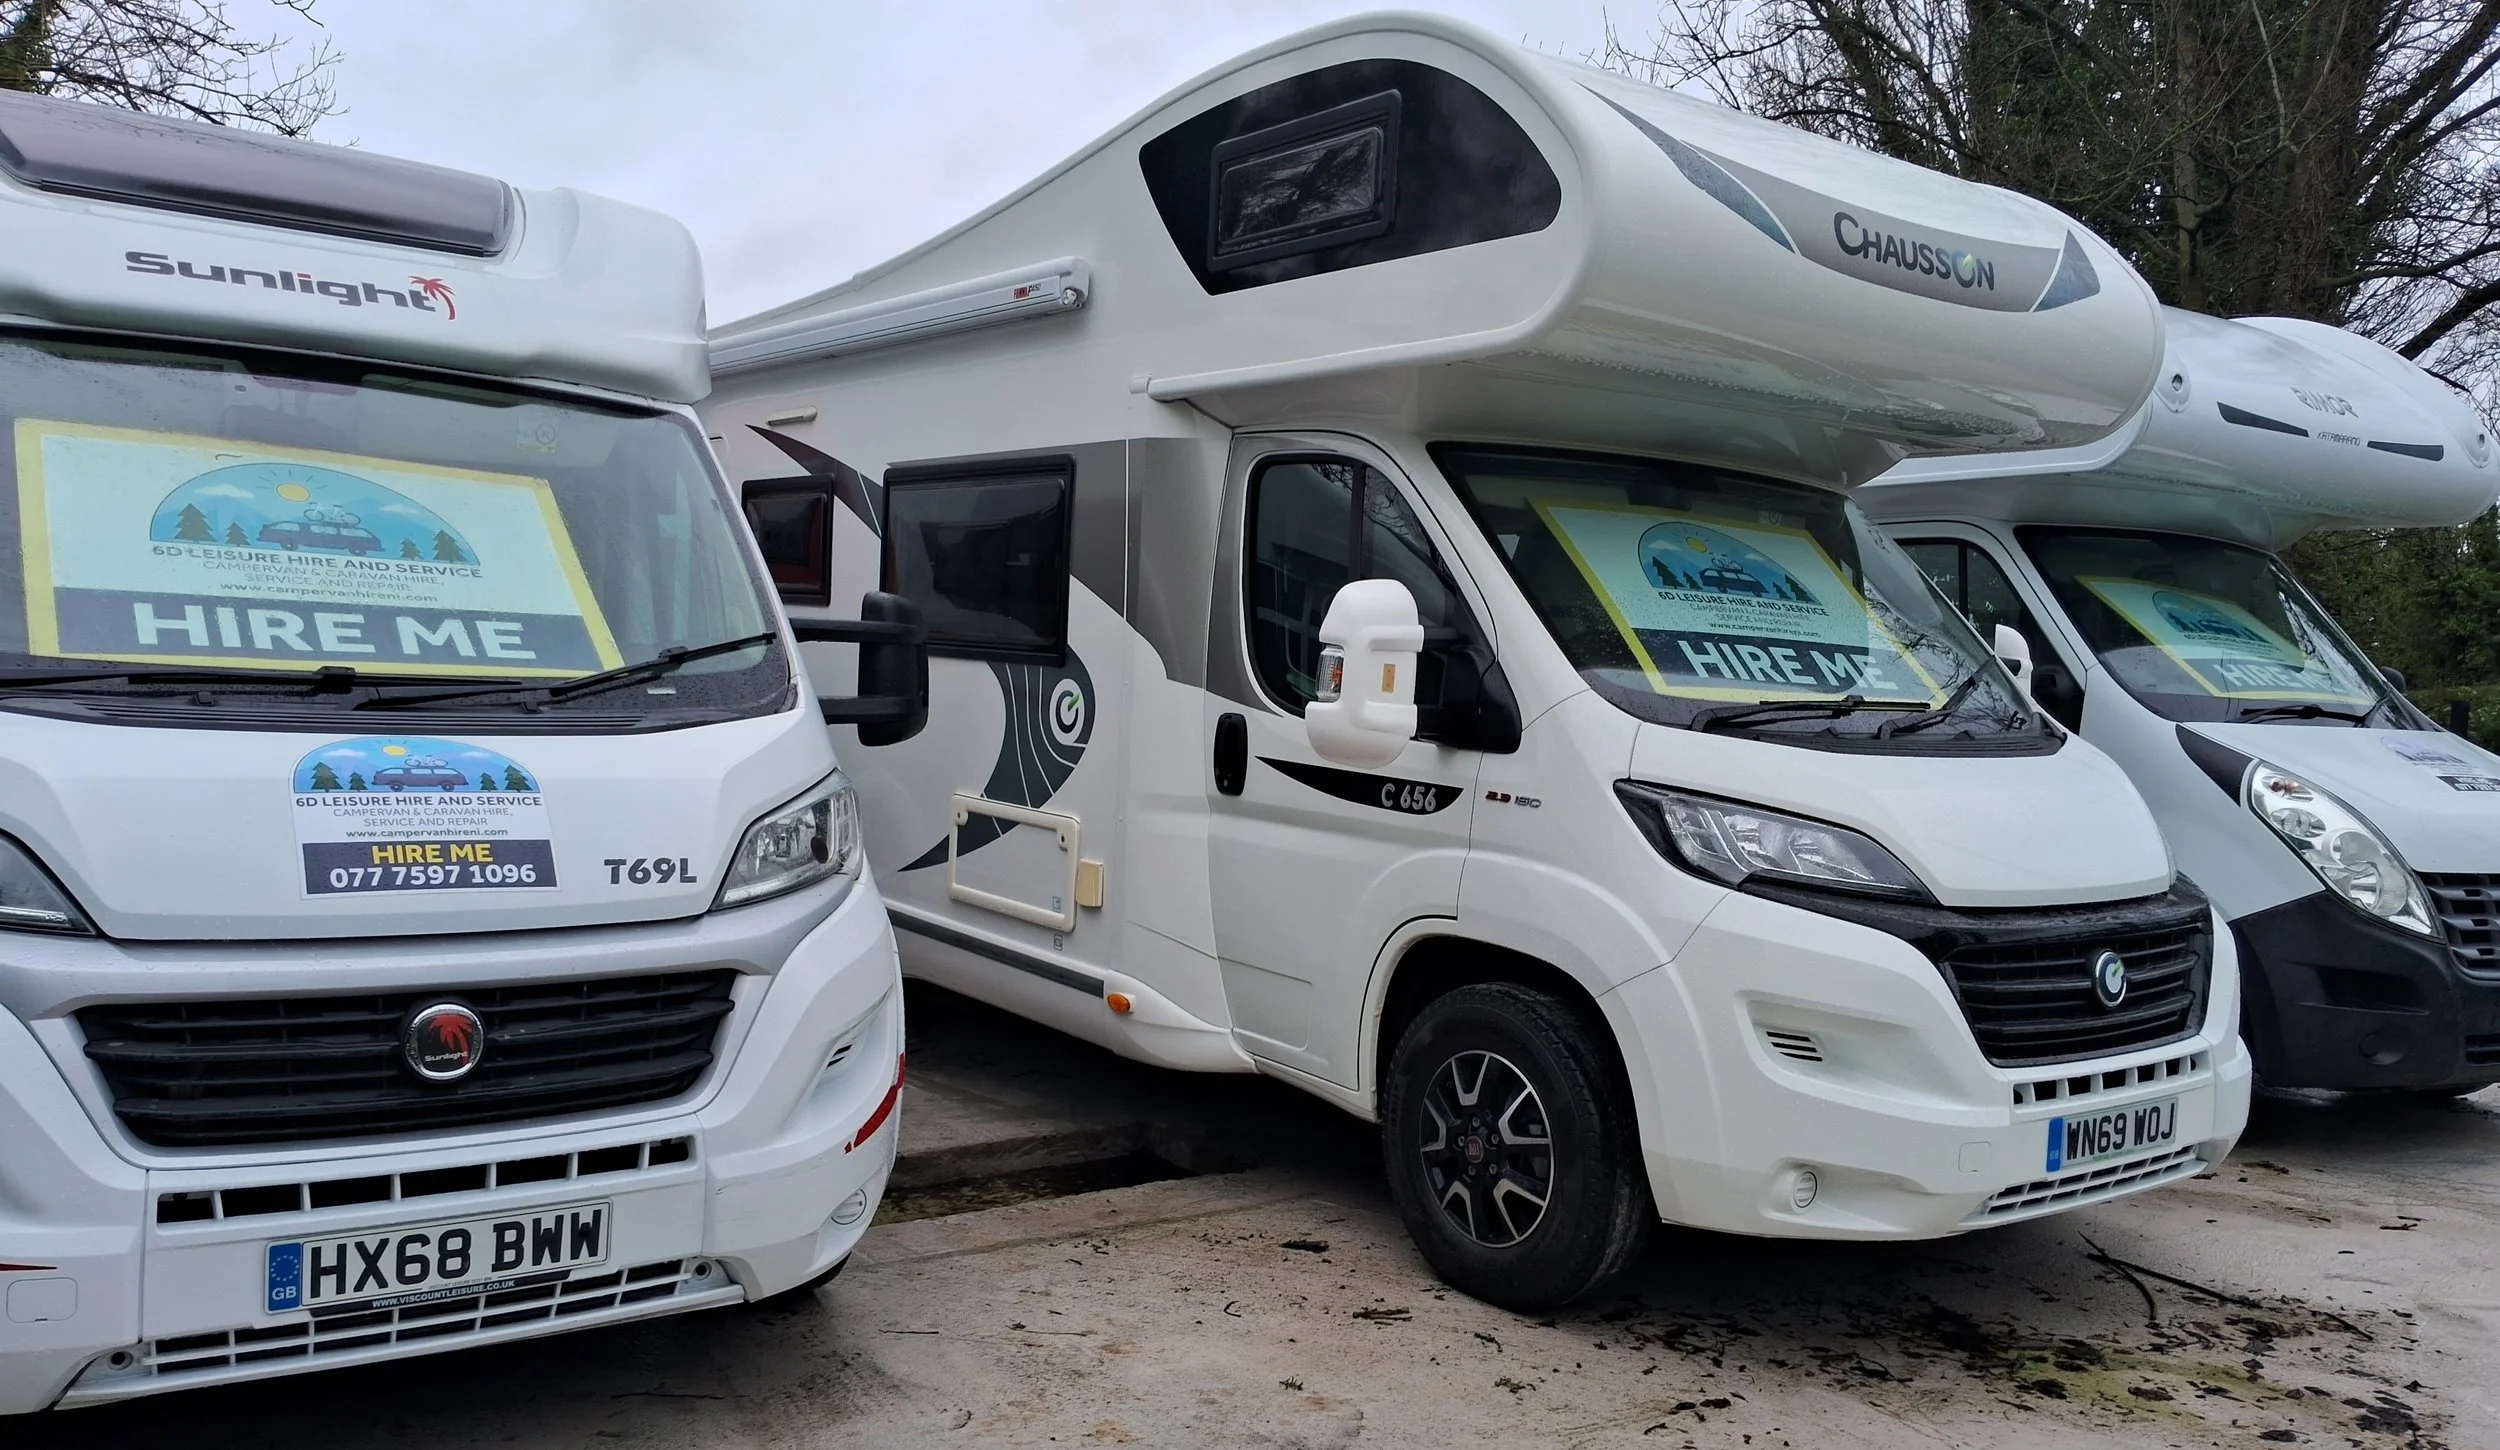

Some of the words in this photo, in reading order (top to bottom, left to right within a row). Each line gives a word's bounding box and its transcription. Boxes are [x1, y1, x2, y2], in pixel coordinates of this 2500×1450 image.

[1833, 211, 1995, 291] CHAUSSON
[125, 250, 437, 313] Sunlight
[153, 545, 183, 557] 6D
[188, 547, 282, 564] LEISURE
[287, 554, 338, 568] HIRE
[343, 559, 390, 572] AND
[395, 563, 484, 578] SERVICE
[202, 560, 307, 575] CAMPERVAN
[310, 567, 321, 576] &
[324, 569, 401, 582] CARAVAN
[244, 573, 313, 585] SERVICE
[318, 579, 353, 588] AND
[356, 581, 411, 592] REPAIR
[1658, 591, 1676, 600] 6D
[1676, 592, 1728, 605] LEISURE
[1727, 597, 1757, 608] HIRE
[1757, 600, 1782, 611] AND
[1781, 603, 1831, 617] SERVICE
[133, 602, 376, 653] HIRE
[396, 616, 537, 660] ME
[1676, 640, 1818, 686] HIRE
[1808, 650, 1899, 690] ME
[2213, 663, 2305, 688] HIRE
[296, 797, 318, 807] 6D
[322, 796, 393, 807] LEISURE
[395, 796, 434, 806] HIRE
[437, 796, 473, 806] AND
[476, 796, 543, 806] SERVICE
[1381, 782, 1396, 808] C
[1399, 784, 1437, 812] 656
[333, 808, 410, 817] CAMPERVAN
[412, 808, 421, 816] &
[424, 807, 481, 816] CARAVAN
[483, 807, 514, 817] HIRE,
[363, 818, 416, 827] SERVICE
[418, 817, 445, 826] AND
[447, 817, 489, 826] REPAIR
[345, 828, 509, 838] www.campervanhireni.com
[371, 844, 444, 864] HIRE
[449, 843, 494, 862] ME
[329, 866, 384, 888] 077
[391, 865, 462, 886] 7597
[470, 864, 537, 884] 1096
[603, 857, 698, 885] T69L
[424, 1051, 469, 1062] Sunlight
[2066, 1112, 2128, 1161] WN69
[2133, 1102, 2176, 1147] WOJ
[309, 1228, 473, 1300] HX68
[490, 1208, 603, 1274] BWW
[271, 1285, 298, 1301] GB
[372, 1279, 516, 1309] WWW.VISCOUNTLEISURE.CO.UK
